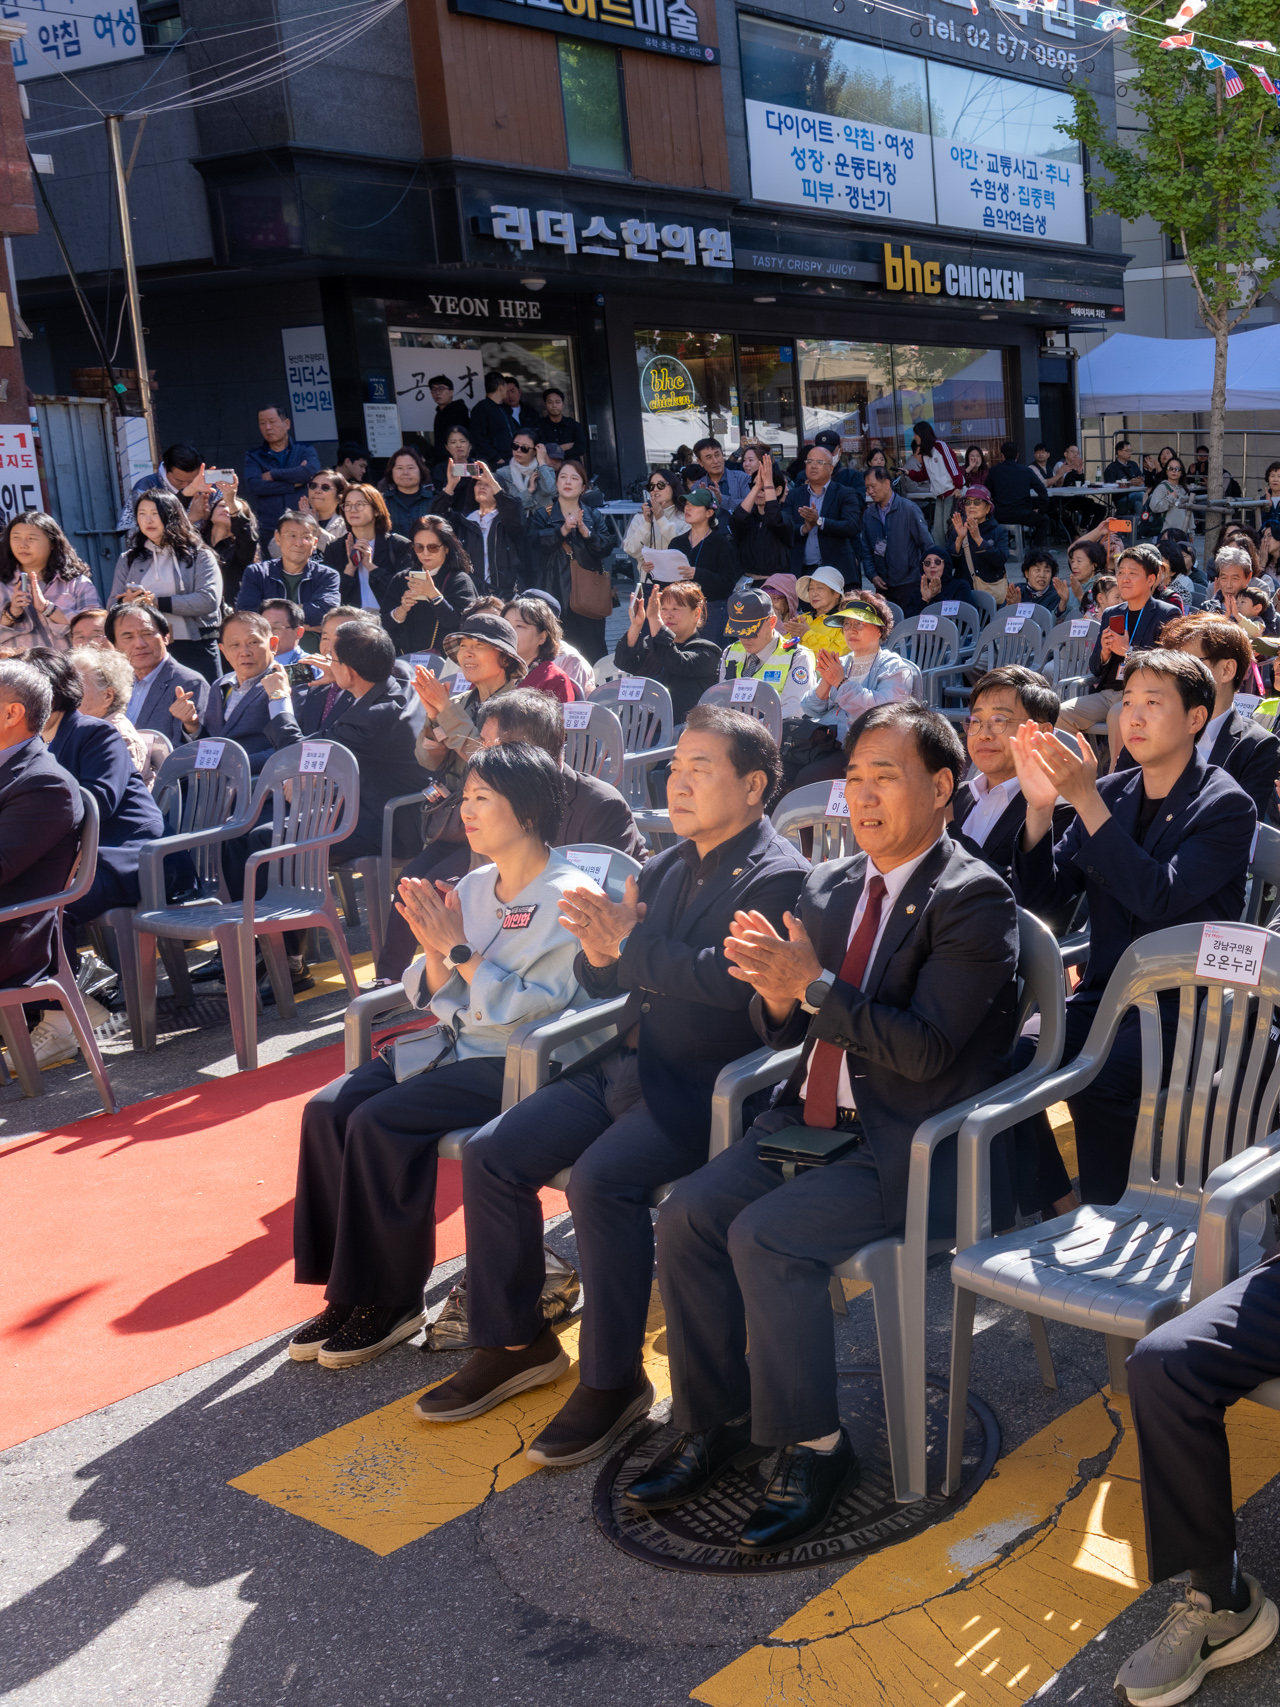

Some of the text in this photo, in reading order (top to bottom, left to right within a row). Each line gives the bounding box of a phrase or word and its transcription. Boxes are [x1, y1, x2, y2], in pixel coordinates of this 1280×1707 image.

[38, 19, 82, 60] 약침
[93, 6, 137, 48] 여성
[925, 13, 961, 43] Tel.
[966, 25, 991, 51] 02
[996, 33, 1029, 61] 577
[982, 206, 1047, 235] 음악연습생
[490, 204, 734, 268] 리더스한의원
[751, 255, 785, 270] TASTY,
[826, 262, 856, 276] JUICY!
[884, 242, 1025, 302] bhc CHICKEN
[429, 294, 541, 320] YEON HEE
[289, 365, 330, 388] 리더스
[650, 368, 686, 392] bhc
[292, 390, 333, 413] 한의원
[649, 391, 691, 410] chicken
[502, 912, 531, 928] 이인화
[1213, 940, 1253, 955] 강남구의원
[1203, 953, 1257, 976] 오온누리
